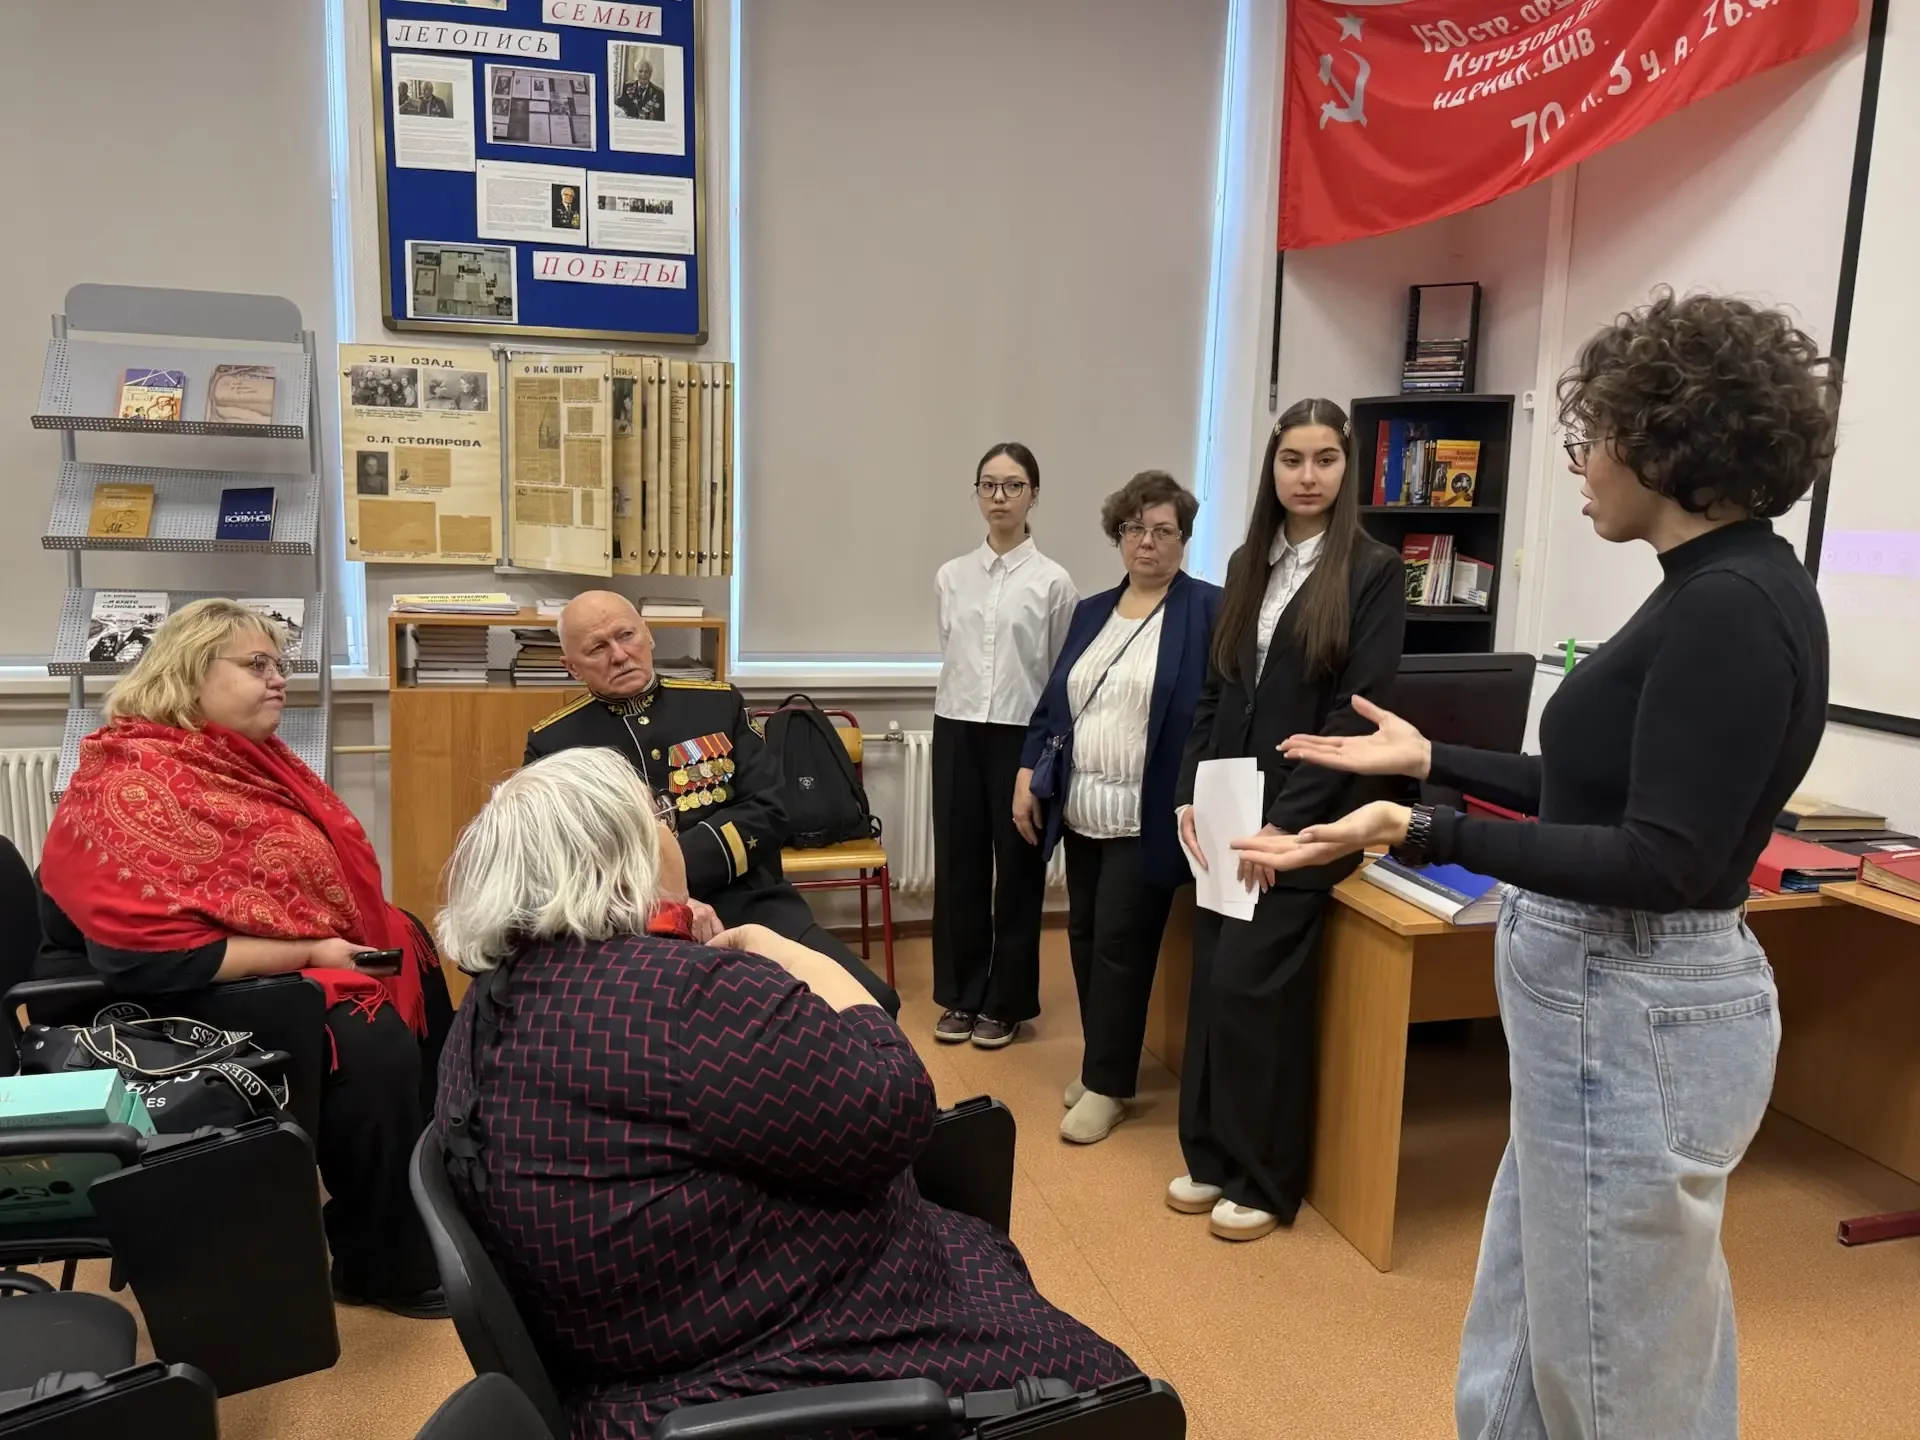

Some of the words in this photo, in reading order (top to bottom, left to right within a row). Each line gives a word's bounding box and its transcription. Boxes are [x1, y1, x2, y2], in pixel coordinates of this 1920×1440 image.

[551, 1, 654, 29] СЕМЬИ
[395, 25, 549, 53] ЛЕТОПИСЬ
[1411, 19, 1469, 53] 150
[542, 256, 679, 284] ПОБЕДЫ
[368, 355, 395, 364] 321
[411, 357, 454, 368] ОЗАД
[533, 366, 549, 374] НАС
[553, 366, 584, 374] ПИШУТ
[397, 436, 482, 448] СТОЛЯРОВА
